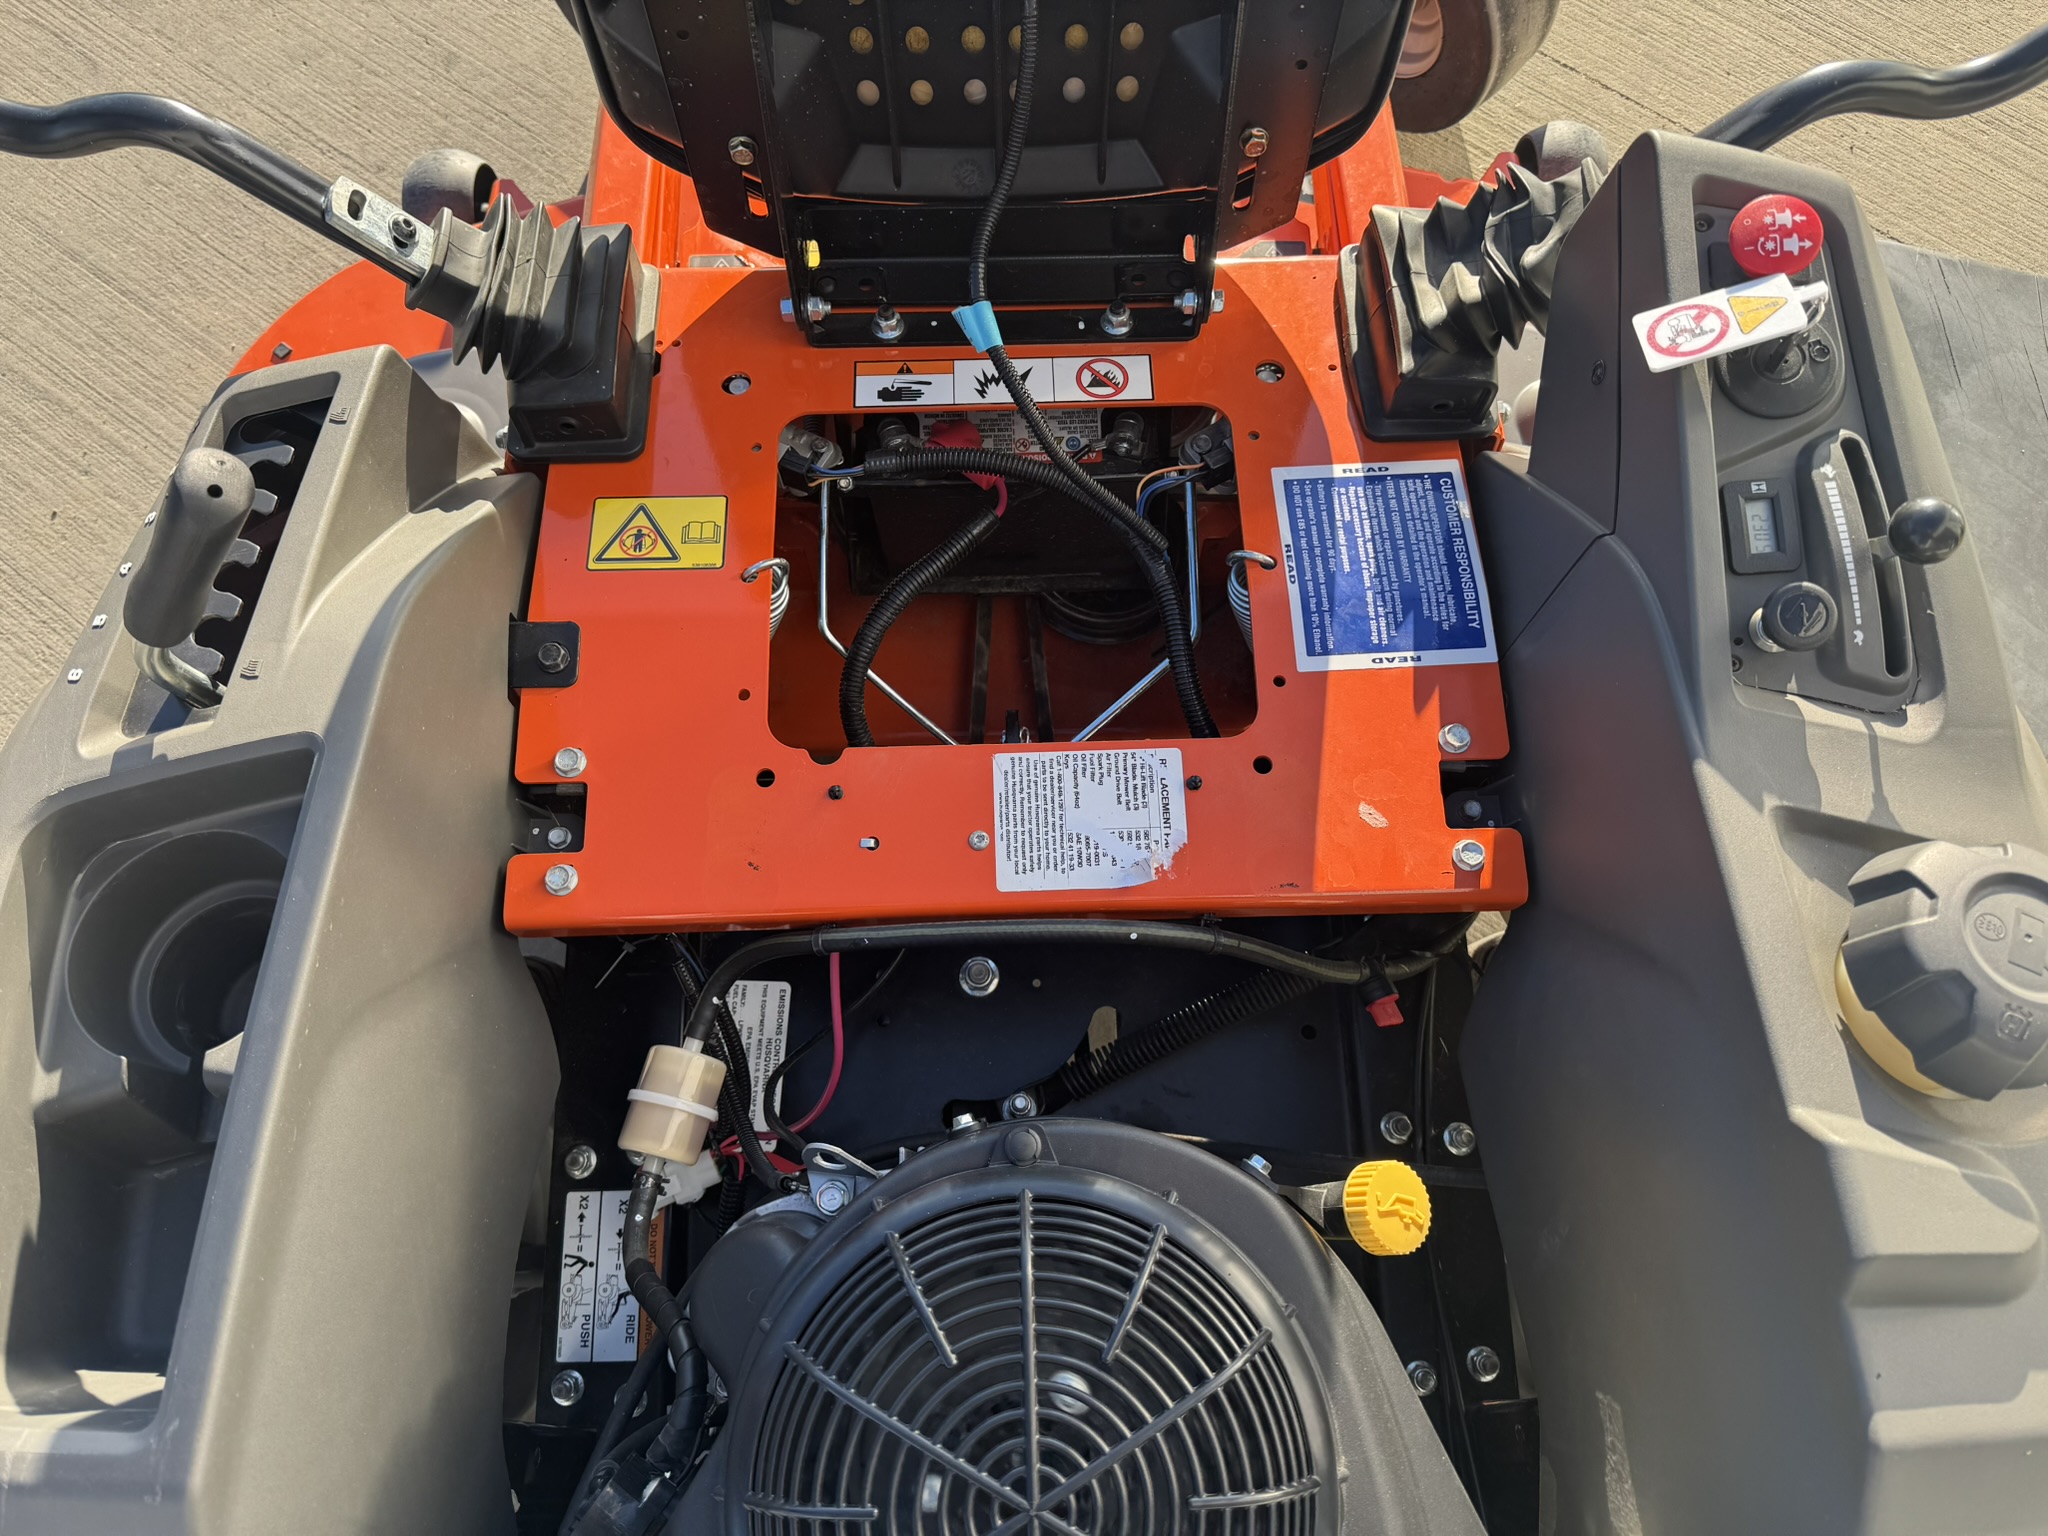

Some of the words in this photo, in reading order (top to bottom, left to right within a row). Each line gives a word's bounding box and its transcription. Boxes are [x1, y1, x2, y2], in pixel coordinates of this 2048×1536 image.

[1342, 466, 1390, 474] READ
[1284, 543, 1296, 584] READ
[1439, 478, 1461, 534] CUSTOMER
[1452, 538, 1480, 628] RESPONSIBILITY
[1370, 654, 1422, 664] READ
[758, 999, 767, 1037] EQUIPMENT
[774, 988, 786, 1036] EMISSIONS
[578, 1195, 589, 1210] X2
[618, 1200, 628, 1214] X2
[650, 1223, 658, 1236] DO
[580, 1314, 591, 1348] PUSH
[625, 1314, 635, 1344] RIDE
